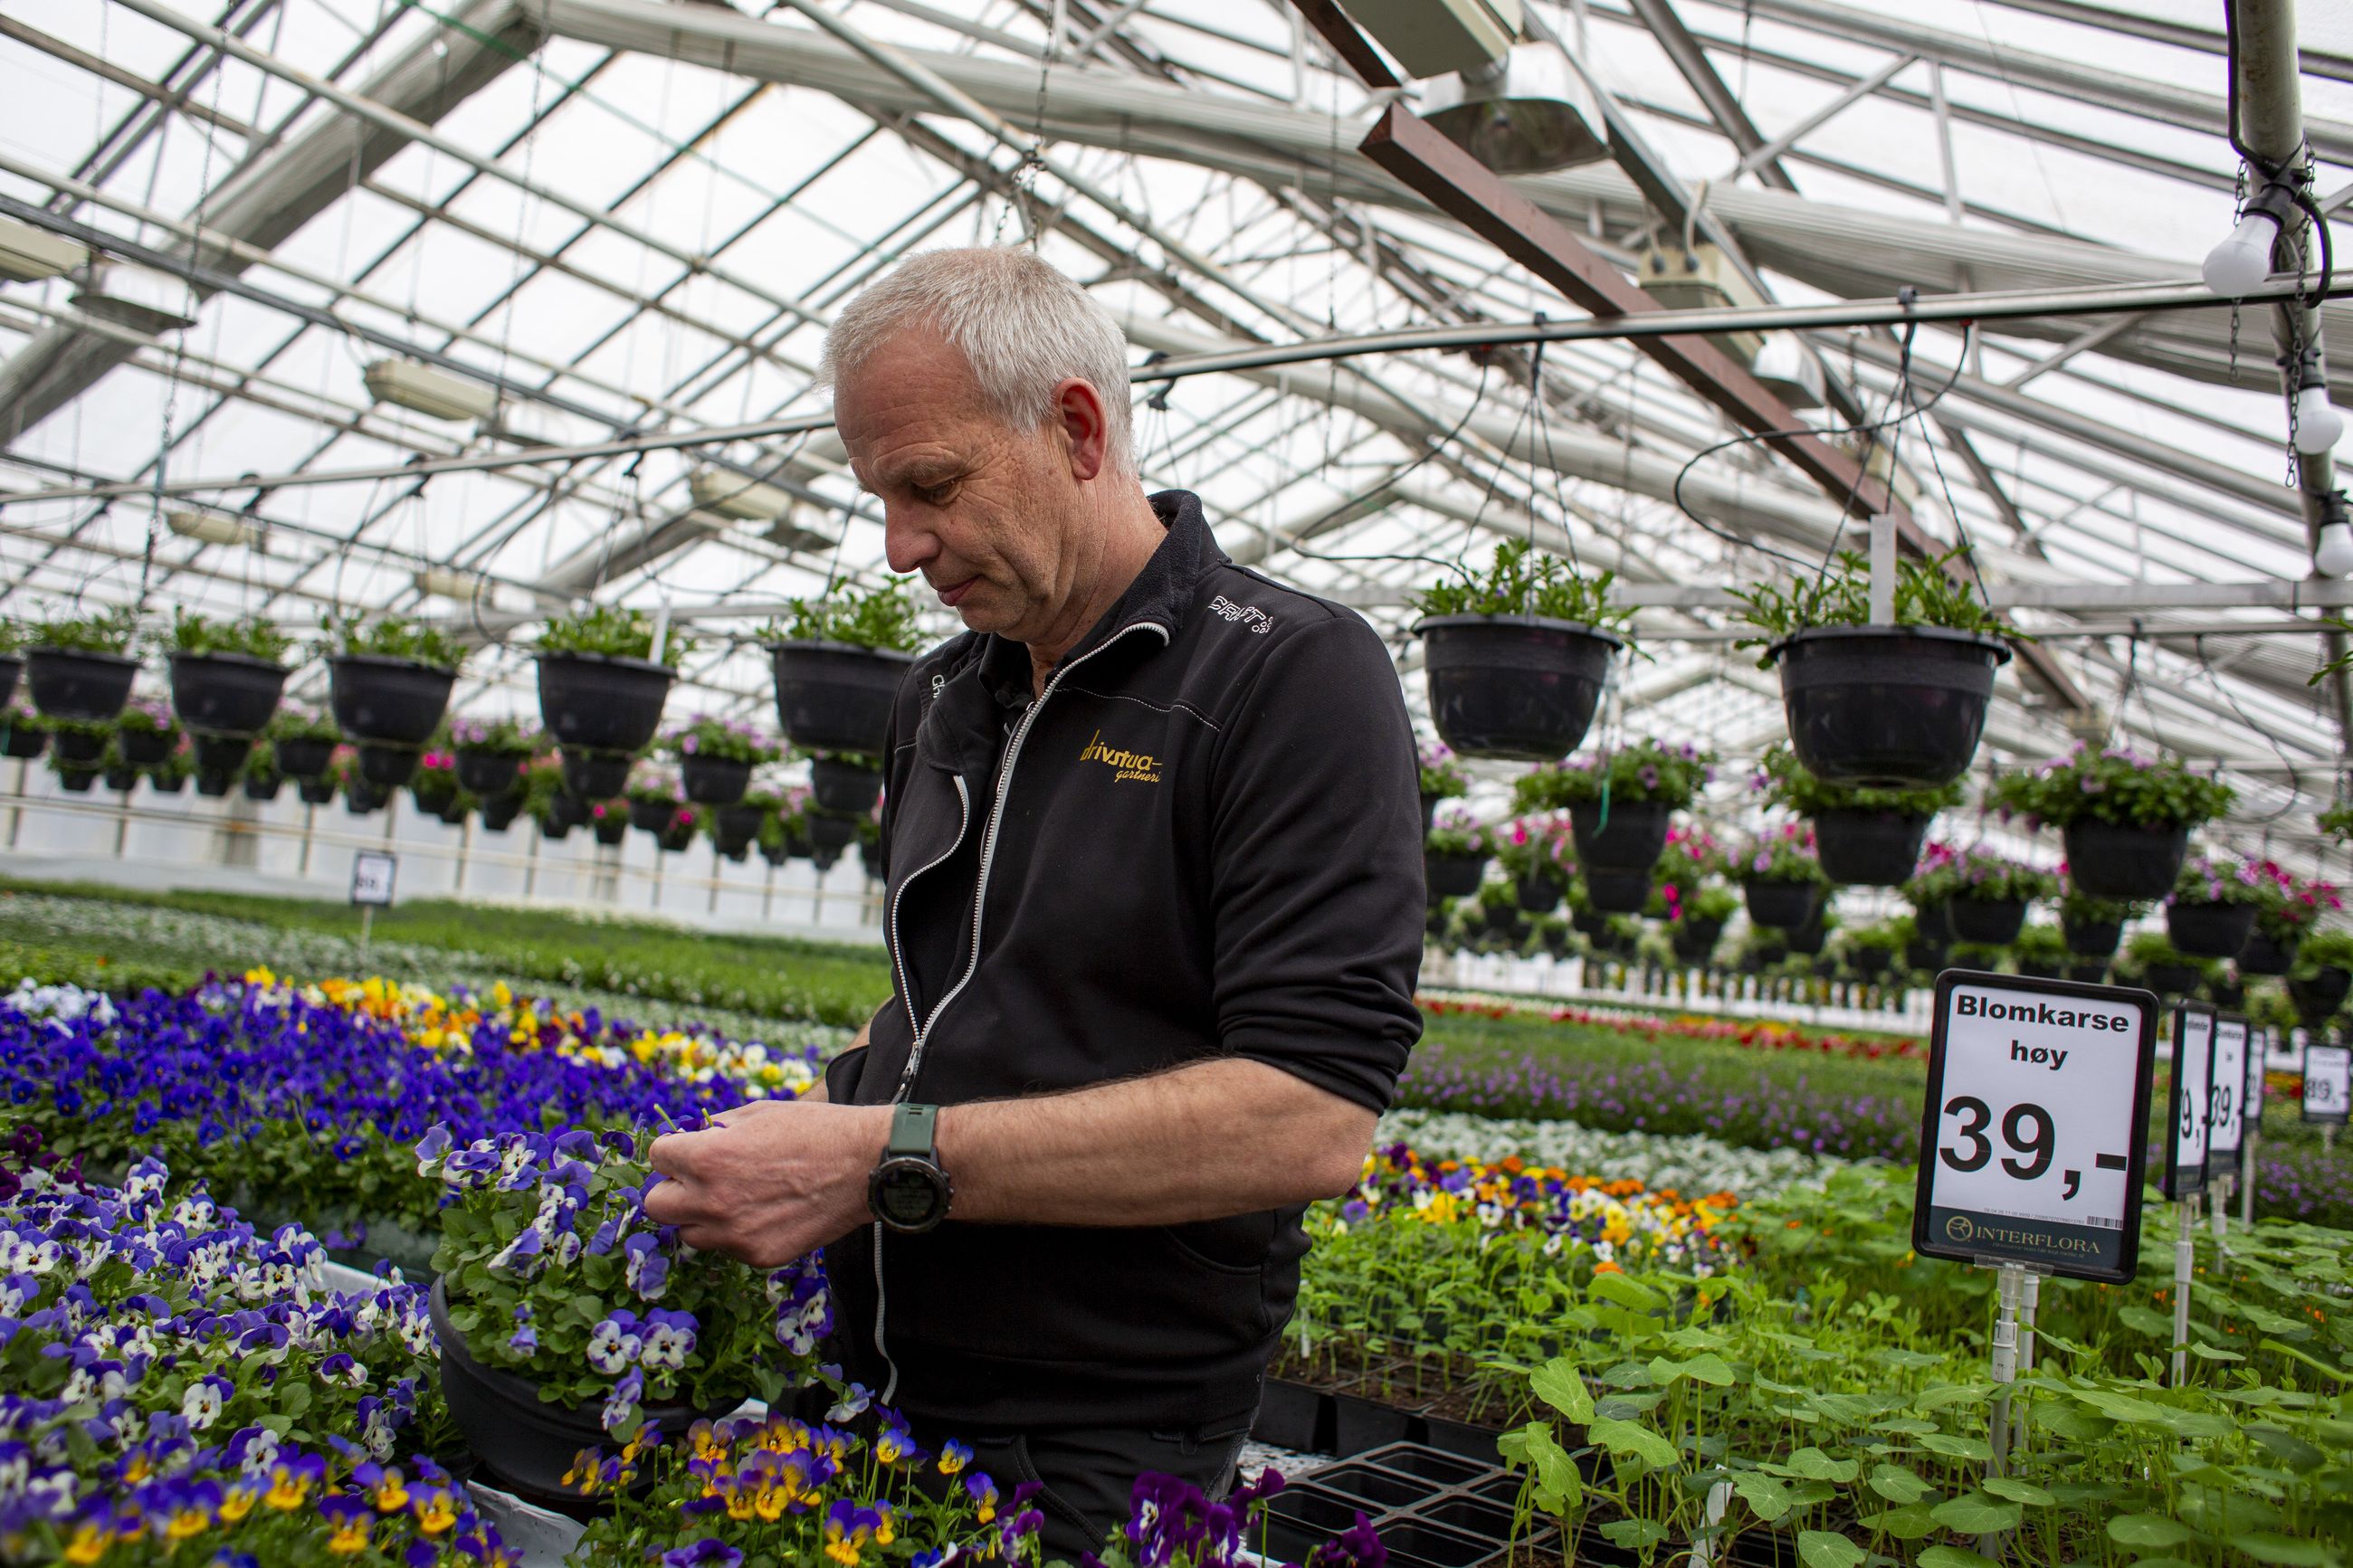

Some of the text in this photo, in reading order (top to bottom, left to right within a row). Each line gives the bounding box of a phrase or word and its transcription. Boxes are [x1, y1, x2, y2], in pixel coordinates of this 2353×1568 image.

[1114, 768, 1161, 784] gartneri
[1957, 994, 2129, 1032] Blomkarse
[2010, 1040, 2069, 1071] høy
[1939, 1096, 2128, 1202] 39,-
[1977, 1225, 2101, 1255] INTERFLORA
